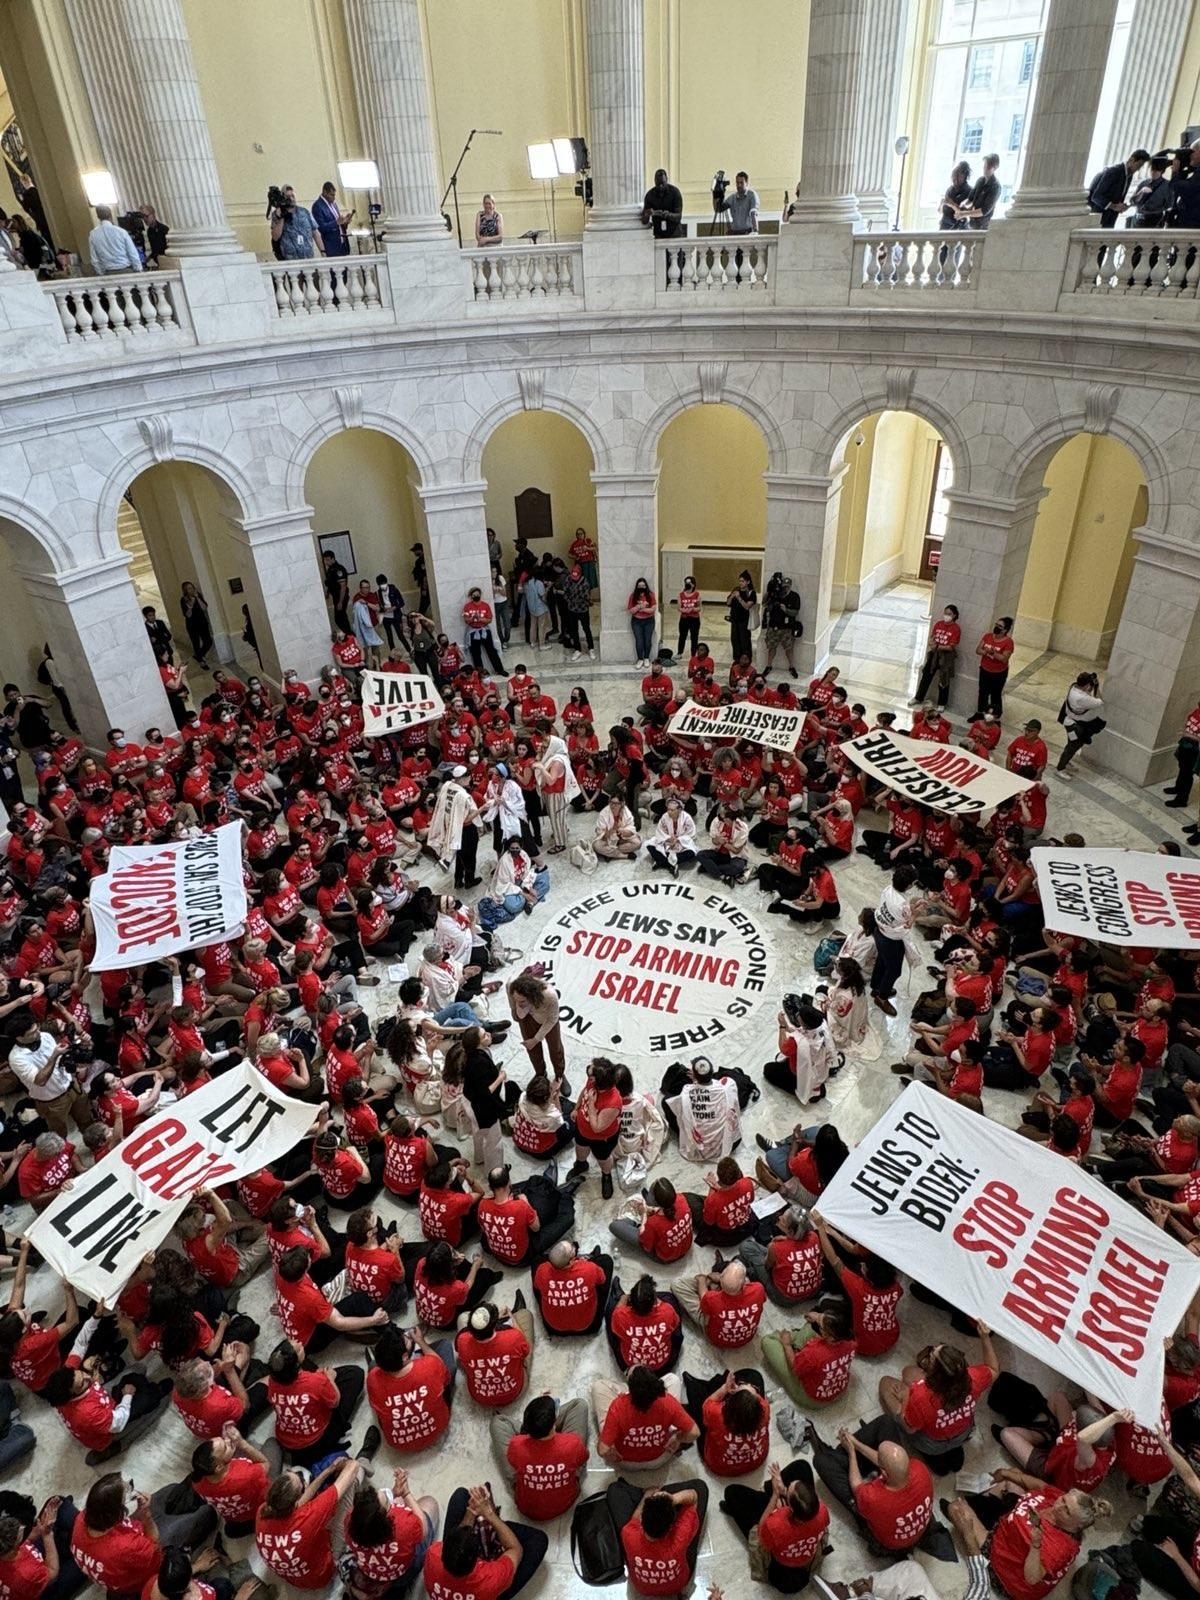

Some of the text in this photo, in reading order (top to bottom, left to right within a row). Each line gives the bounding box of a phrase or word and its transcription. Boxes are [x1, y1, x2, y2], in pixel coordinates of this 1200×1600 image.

[373, 678, 427, 705] LIVE
[687, 706, 798, 732] CEASEFIRE NOW
[852, 732, 988, 812] CEASEFIRE NOW
[184, 885, 222, 910] STOP
[622, 884, 695, 900] UNTIL
[1048, 861, 1090, 922] JEWS TO
[1084, 864, 1132, 936] CONGRESS
[109, 851, 181, 954] NOCIDE
[557, 891, 614, 929] FREE
[1125, 880, 1176, 927] STOP
[187, 912, 226, 942] THE
[604, 910, 727, 948] JEWS SAY
[540, 934, 562, 952] IS
[702, 894, 767, 992] EVERYONE
[566, 930, 740, 987] STOP ARMING
[588, 970, 682, 1014] ISRAEL
[726, 997, 753, 1018] IS
[650, 1018, 726, 1052] FREE
[200, 1084, 286, 1154] LET
[388, 1140, 416, 1155] JEWS
[388, 1150, 412, 1165] SAY
[850, 1112, 941, 1216] JEWS TO
[900, 1152, 980, 1233] BIDEN:
[722, 1192, 751, 1214] JEWS
[50, 1173, 161, 1274] LIVE
[480, 1210, 515, 1226] JEWS
[666, 1213, 690, 1237] STOP
[953, 1180, 1034, 1270] STOP
[484, 1222, 510, 1236] SAY
[786, 1245, 820, 1262] JEWS
[346, 1258, 379, 1274] JEWS
[1002, 1186, 1110, 1344] ARMING
[350, 1270, 374, 1284] SAY
[548, 1277, 584, 1290] STOP
[414, 1280, 446, 1305] JEWS
[548, 1286, 589, 1299] ARMING
[548, 1294, 589, 1307] ISRAEL
[863, 1291, 899, 1306] JEWS
[718, 1303, 759, 1320] JEWS
[865, 1302, 894, 1313] SAY
[1075, 1237, 1170, 1378] ISRAEL
[626, 1322, 667, 1336] JEWS
[724, 1315, 756, 1329] SAY
[631, 1334, 664, 1348] SAY
[468, 1354, 510, 1368] JEWS
[823, 1350, 856, 1372] JEWS
[474, 1366, 508, 1379] SAY
[474, 1375, 510, 1387] STOP
[272, 1393, 310, 1406] JEWS
[384, 1385, 428, 1407] JEWS
[275, 1405, 306, 1416] SAY
[391, 1400, 424, 1420] SAY
[391, 1418, 435, 1436] ARMING
[392, 1412, 430, 1430] STOP
[628, 1424, 663, 1435] STOP
[393, 1426, 437, 1444] ISRAEL
[1130, 1442, 1168, 1456] ISRA
[524, 1472, 570, 1483] ARMING
[526, 1463, 566, 1474] STOP
[524, 1480, 570, 1490] ISRAEL
[896, 1496, 931, 1526] STOP
[256, 1530, 302, 1546] JEWS
[261, 1546, 296, 1562] SAY
[634, 1556, 677, 1568] STOP
